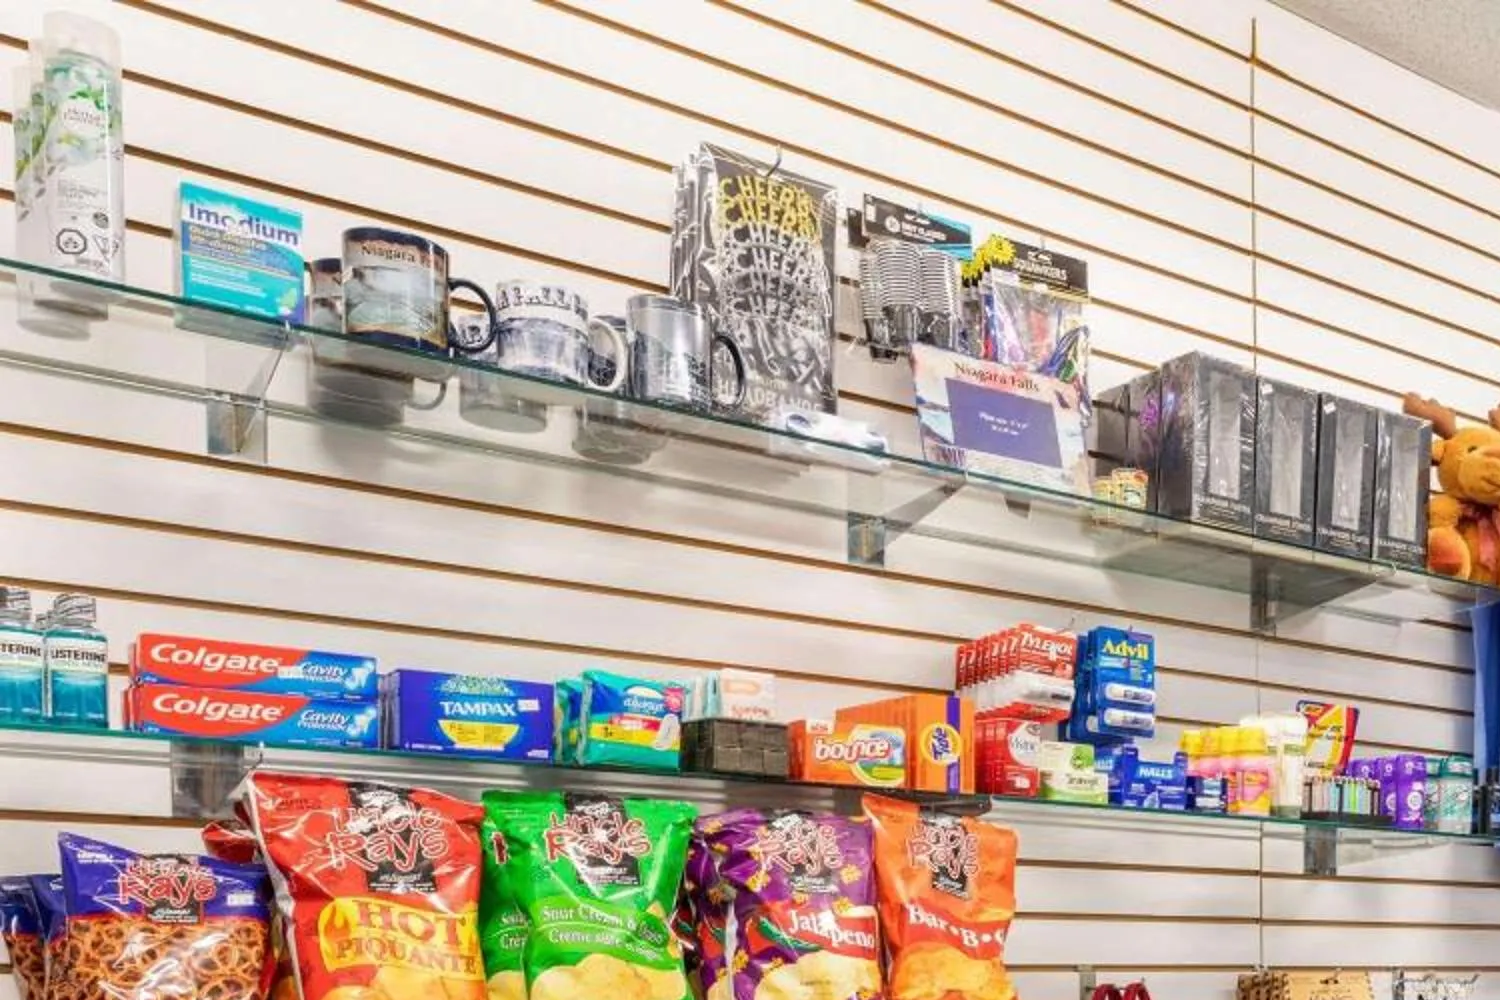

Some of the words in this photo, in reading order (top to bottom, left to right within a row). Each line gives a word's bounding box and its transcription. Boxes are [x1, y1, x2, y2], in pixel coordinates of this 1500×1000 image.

[188, 201, 298, 246] Imodium
[361, 243, 416, 264] Niagara
[954, 361, 1007, 385] Niagara
[1011, 375, 1040, 392] Falls
[151, 643, 279, 673] Colgate
[1102, 638, 1149, 660] Advil
[301, 660, 348, 678] Cavity
[153, 693, 282, 722] Colgate
[301, 709, 348, 726] Cavity
[439, 700, 517, 717] TAMPAX
[814, 737, 890, 761] bounce
[353, 899, 469, 947] HOT
[335, 936, 479, 975] PIQUANTE
